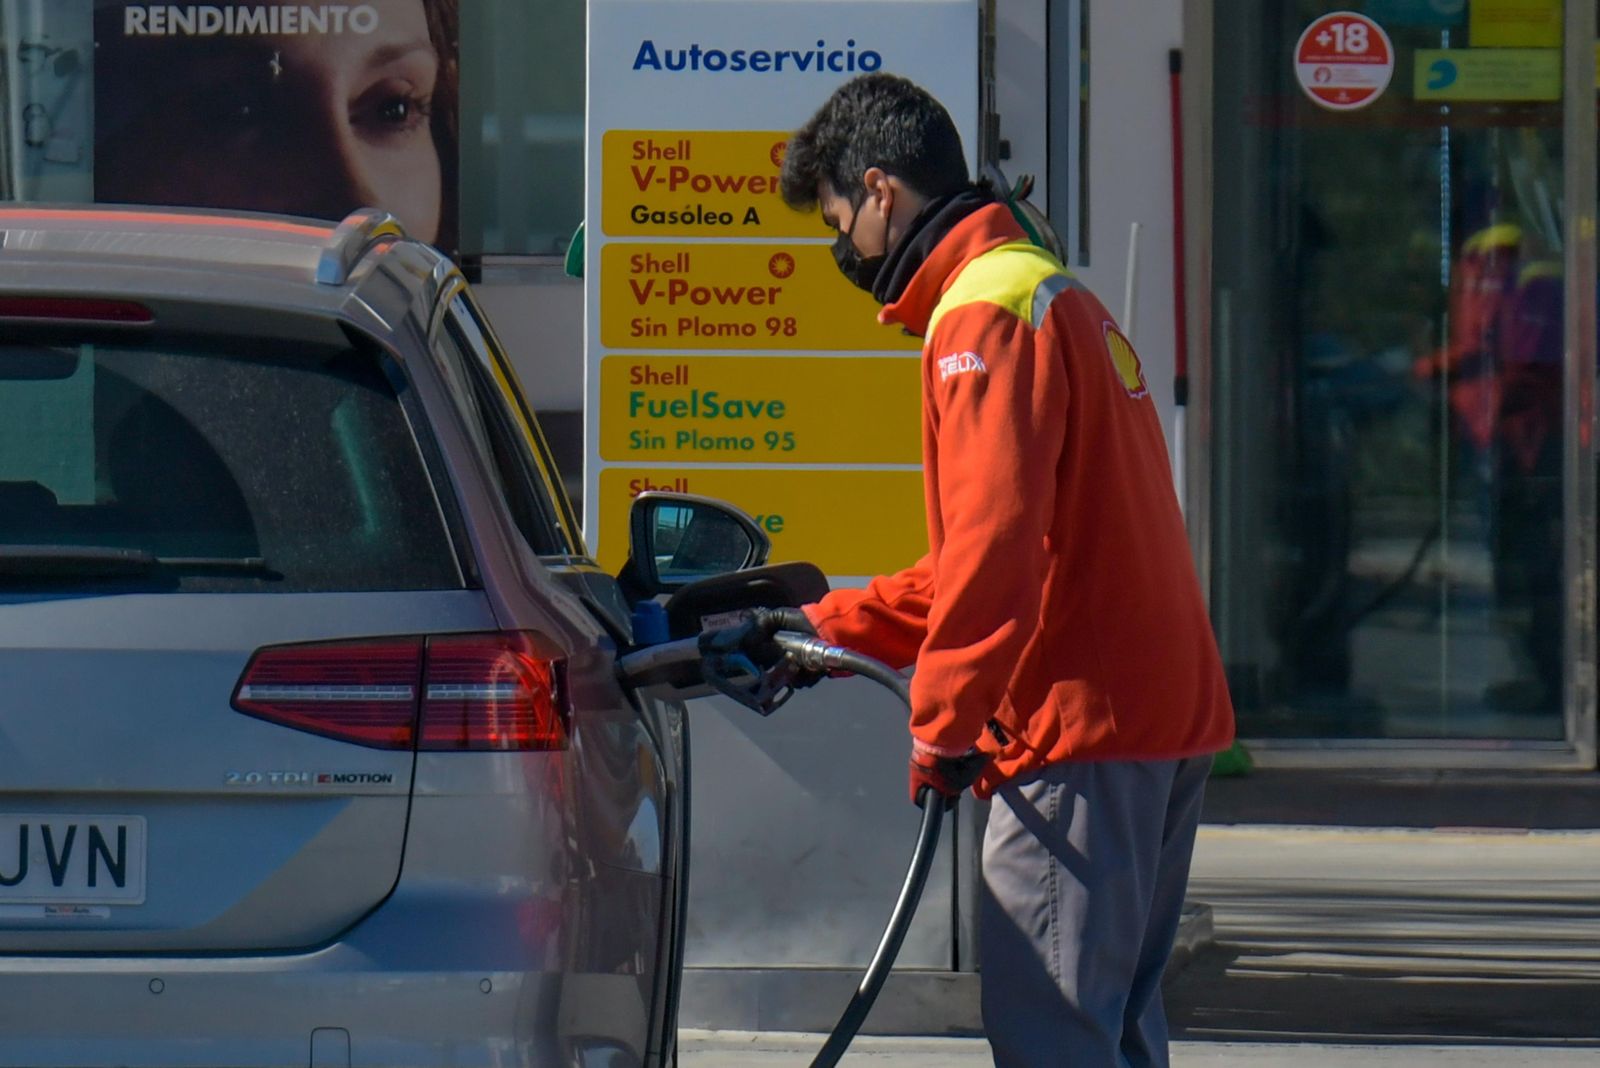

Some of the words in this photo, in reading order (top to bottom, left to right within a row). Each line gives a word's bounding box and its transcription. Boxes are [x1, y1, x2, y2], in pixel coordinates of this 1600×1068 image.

[124, 5, 378, 35] RENDIMIENTO
[1316, 22, 1369, 54] +18
[633, 39, 882, 73] Autoservicio
[632, 140, 691, 161] Shell
[631, 165, 779, 195] V-Power
[630, 204, 733, 226] Gasóleo
[742, 206, 761, 225] A
[630, 253, 690, 274] Shell
[629, 279, 782, 306] V-Power
[630, 317, 668, 337] Sin
[678, 316, 757, 337] Plomo
[765, 317, 797, 337] 98
[629, 365, 689, 386] Shell
[629, 390, 786, 420] FuelSave
[629, 430, 666, 451] Sin
[675, 430, 755, 451] Plomo
[763, 430, 796, 452] 95
[267, 771, 308, 785] TDI
